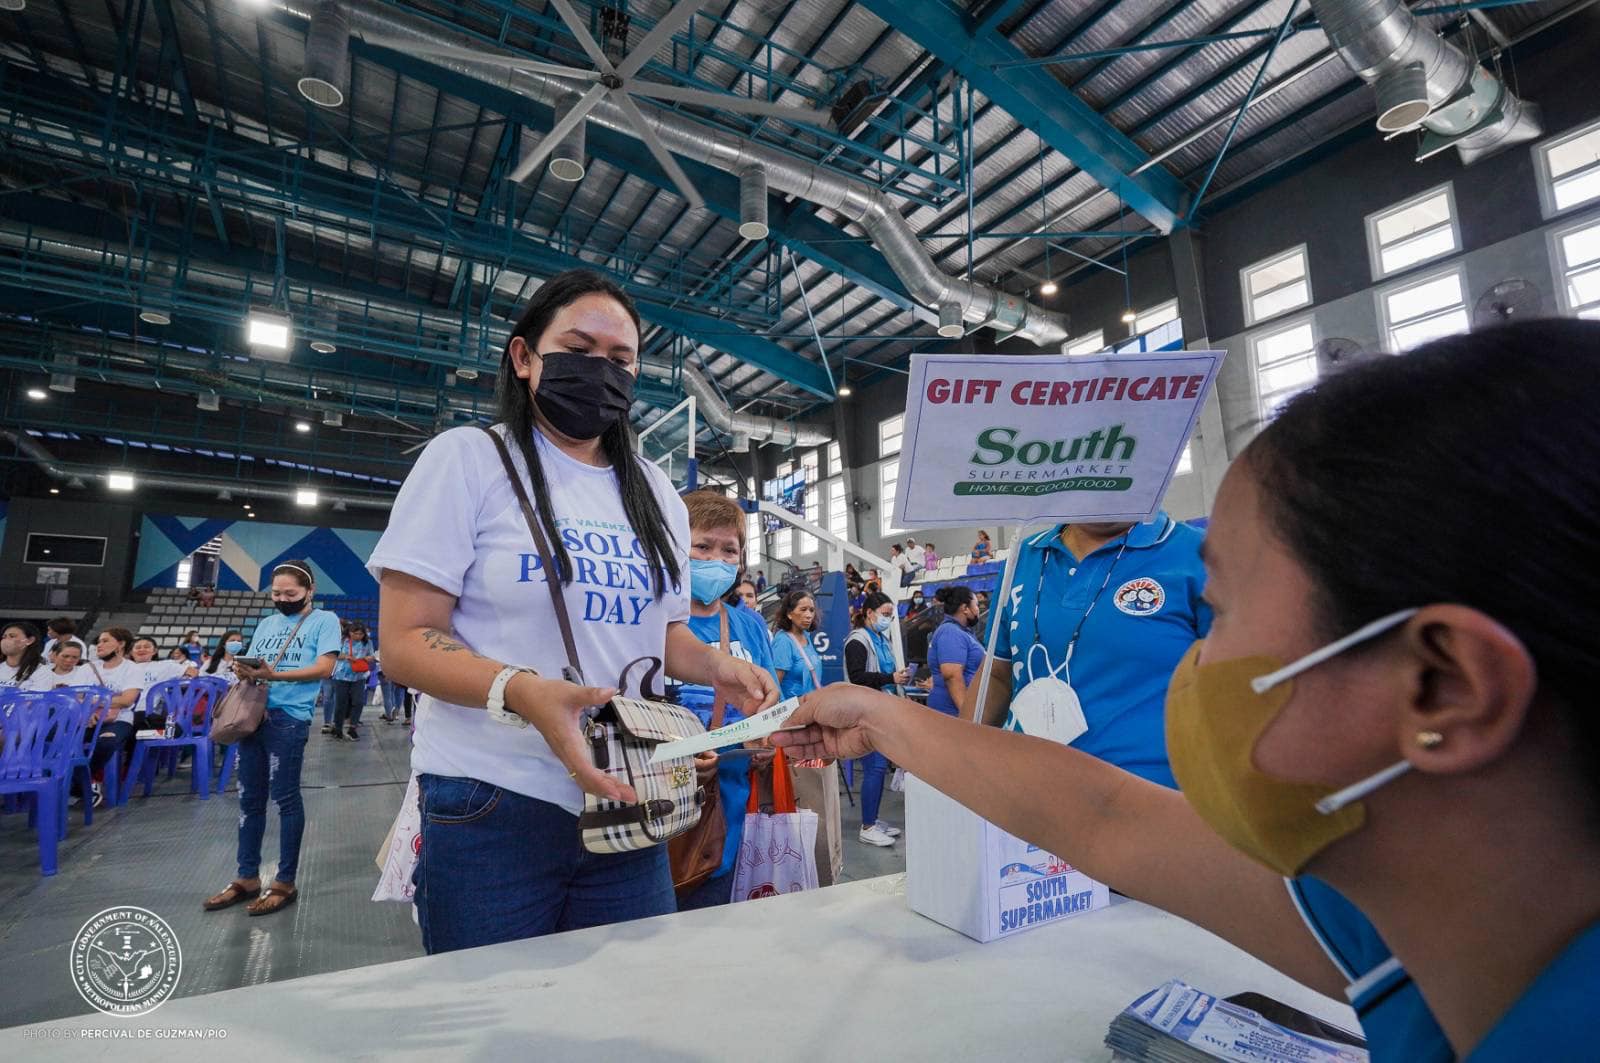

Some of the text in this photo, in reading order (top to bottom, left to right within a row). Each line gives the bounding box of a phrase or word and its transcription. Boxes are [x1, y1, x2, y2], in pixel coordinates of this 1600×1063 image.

[926, 374, 1205, 407] GIFT CERTIFICATE
[970, 422, 1137, 467] South
[968, 464, 1129, 480] SUPERMARKET
[968, 477, 1118, 494] HOME OF GOOD FOOD
[583, 591, 653, 626] DAY
[1026, 875, 1068, 903] SOUTH
[1001, 890, 1093, 931] SUPERMARKET
